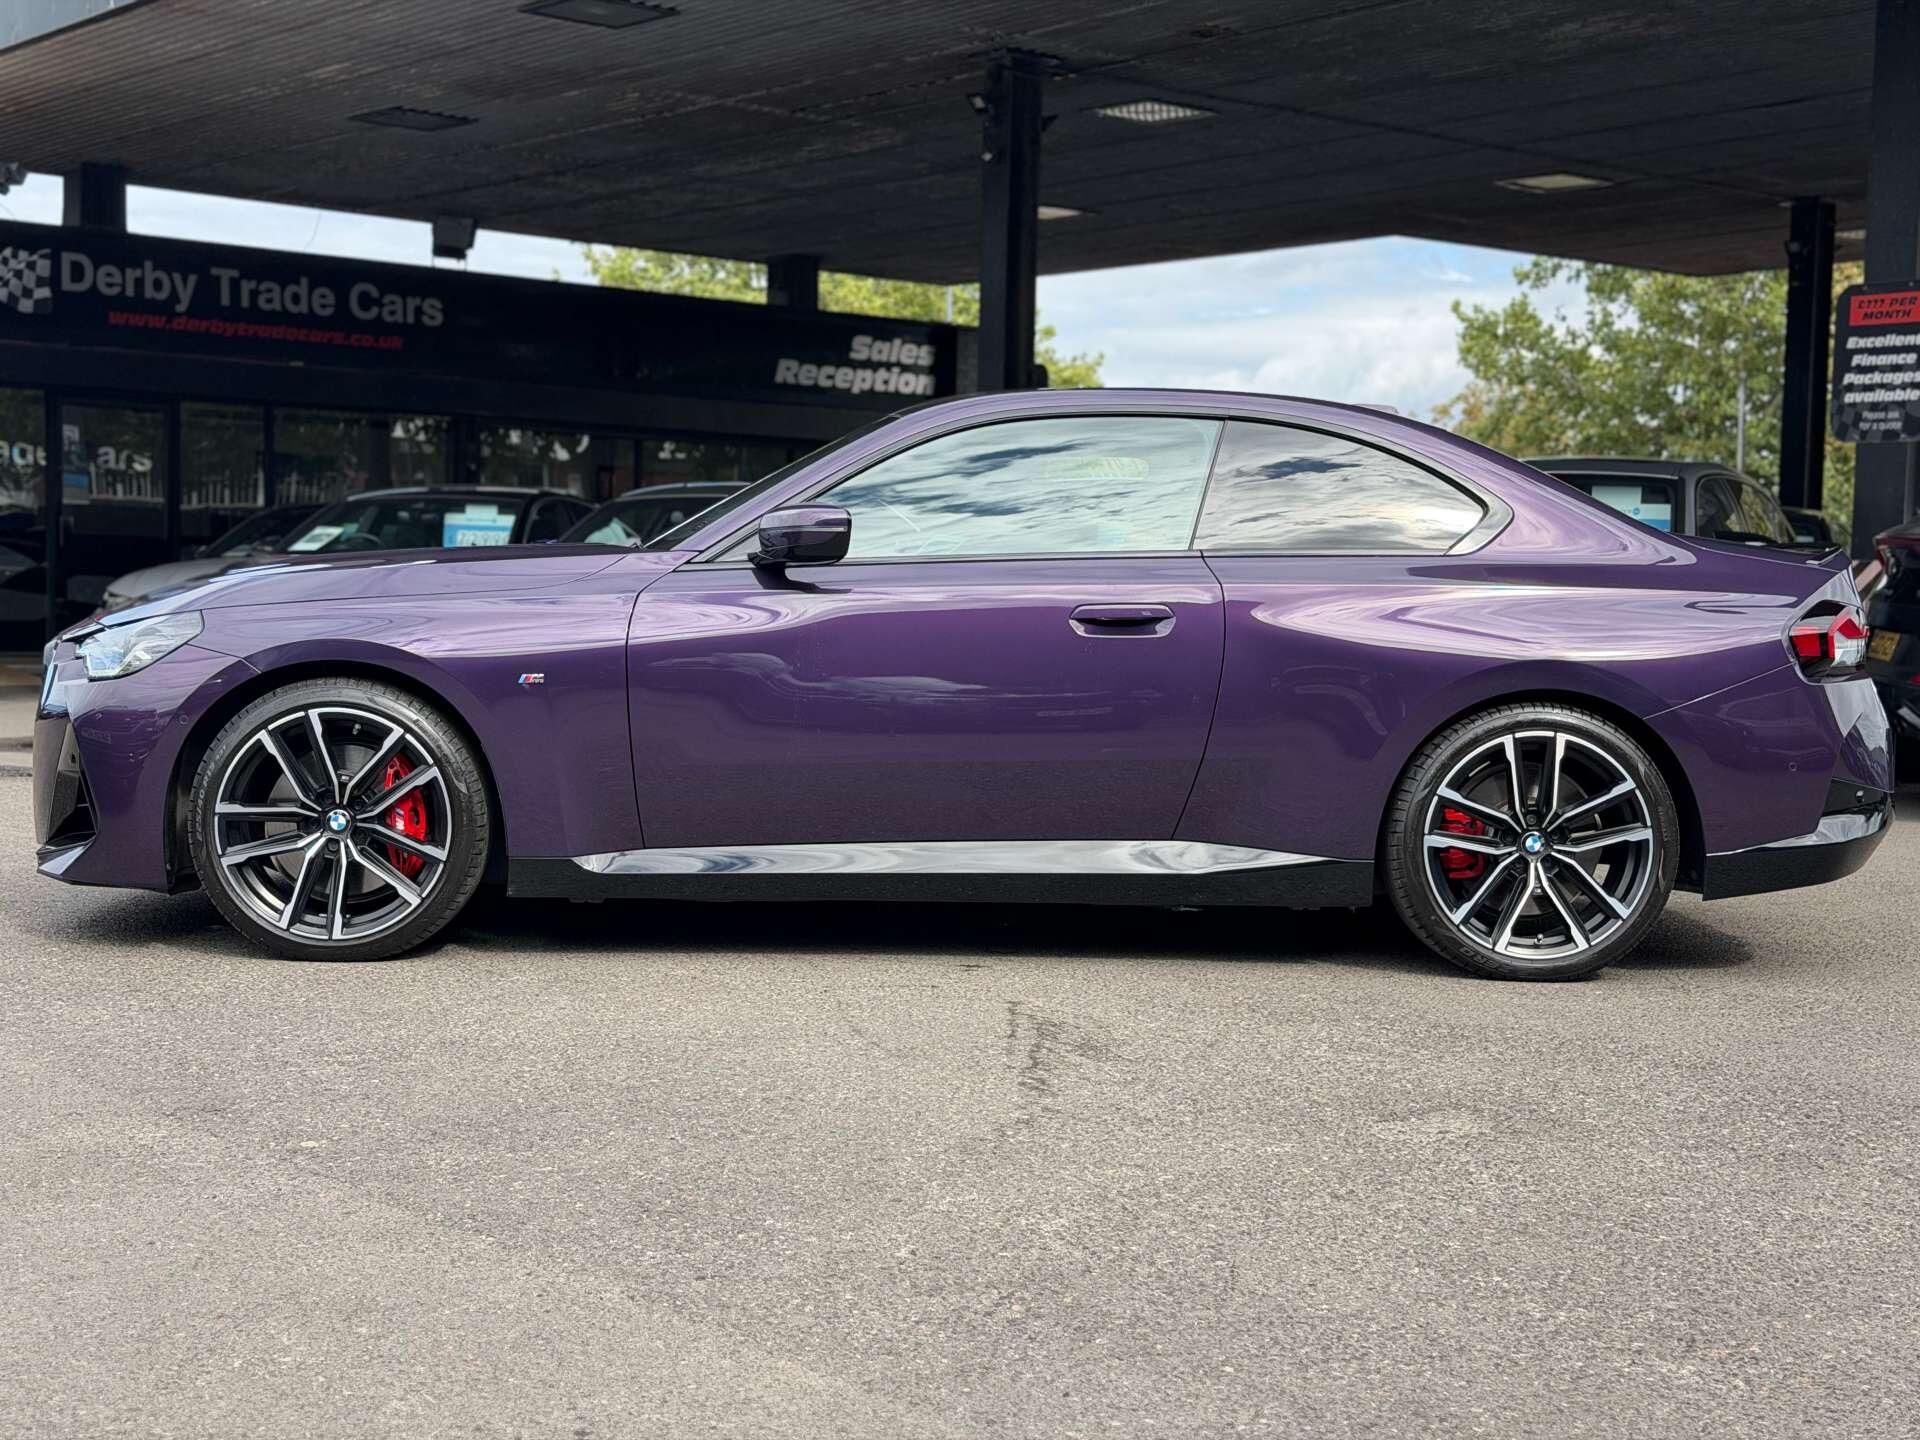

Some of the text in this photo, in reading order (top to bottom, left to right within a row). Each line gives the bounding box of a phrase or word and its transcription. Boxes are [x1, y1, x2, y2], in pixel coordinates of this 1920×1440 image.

[60, 252, 445, 327] Derby Trade Cars
[1889, 296, 1917, 307] PER
[1862, 308, 1912, 321] MONTH
[108, 310, 403, 349] www.derbytradecars.co.uk
[1846, 334, 1920, 349] Excellent
[849, 334, 935, 366] Sales
[1851, 353, 1918, 367] Finance
[774, 358, 935, 395] Reception
[1842, 371, 1920, 385] Packages
[1844, 388, 1920, 404] available
